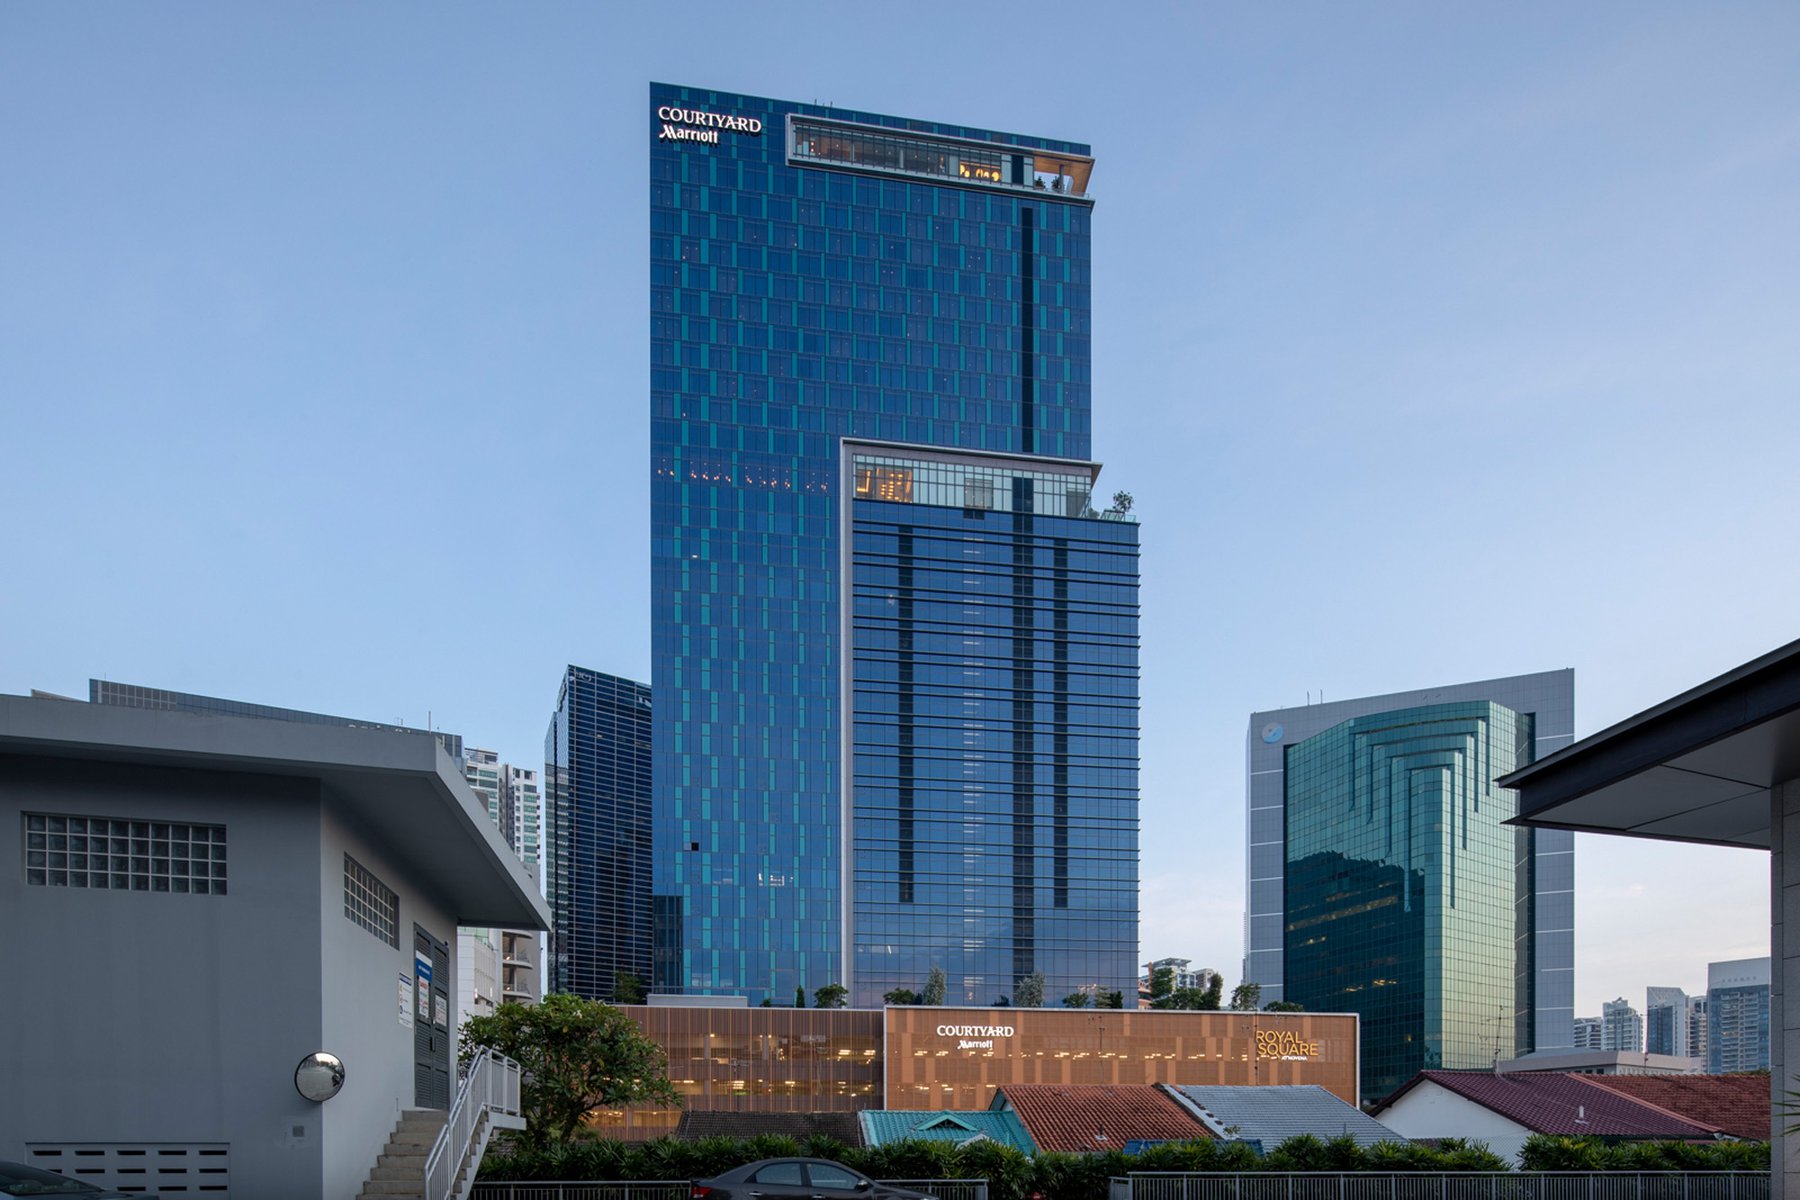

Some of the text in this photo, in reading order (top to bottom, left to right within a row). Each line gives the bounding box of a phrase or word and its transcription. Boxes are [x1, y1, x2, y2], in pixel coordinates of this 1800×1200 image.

[658, 106, 762, 133] COURTYARD
[659, 124, 718, 144] Marriott
[936, 1025, 1014, 1037] COURTYARD
[1256, 1031, 1303, 1043] ROYAL
[957, 1040, 993, 1049] Marriott
[1258, 1043, 1319, 1057] SQUARE
